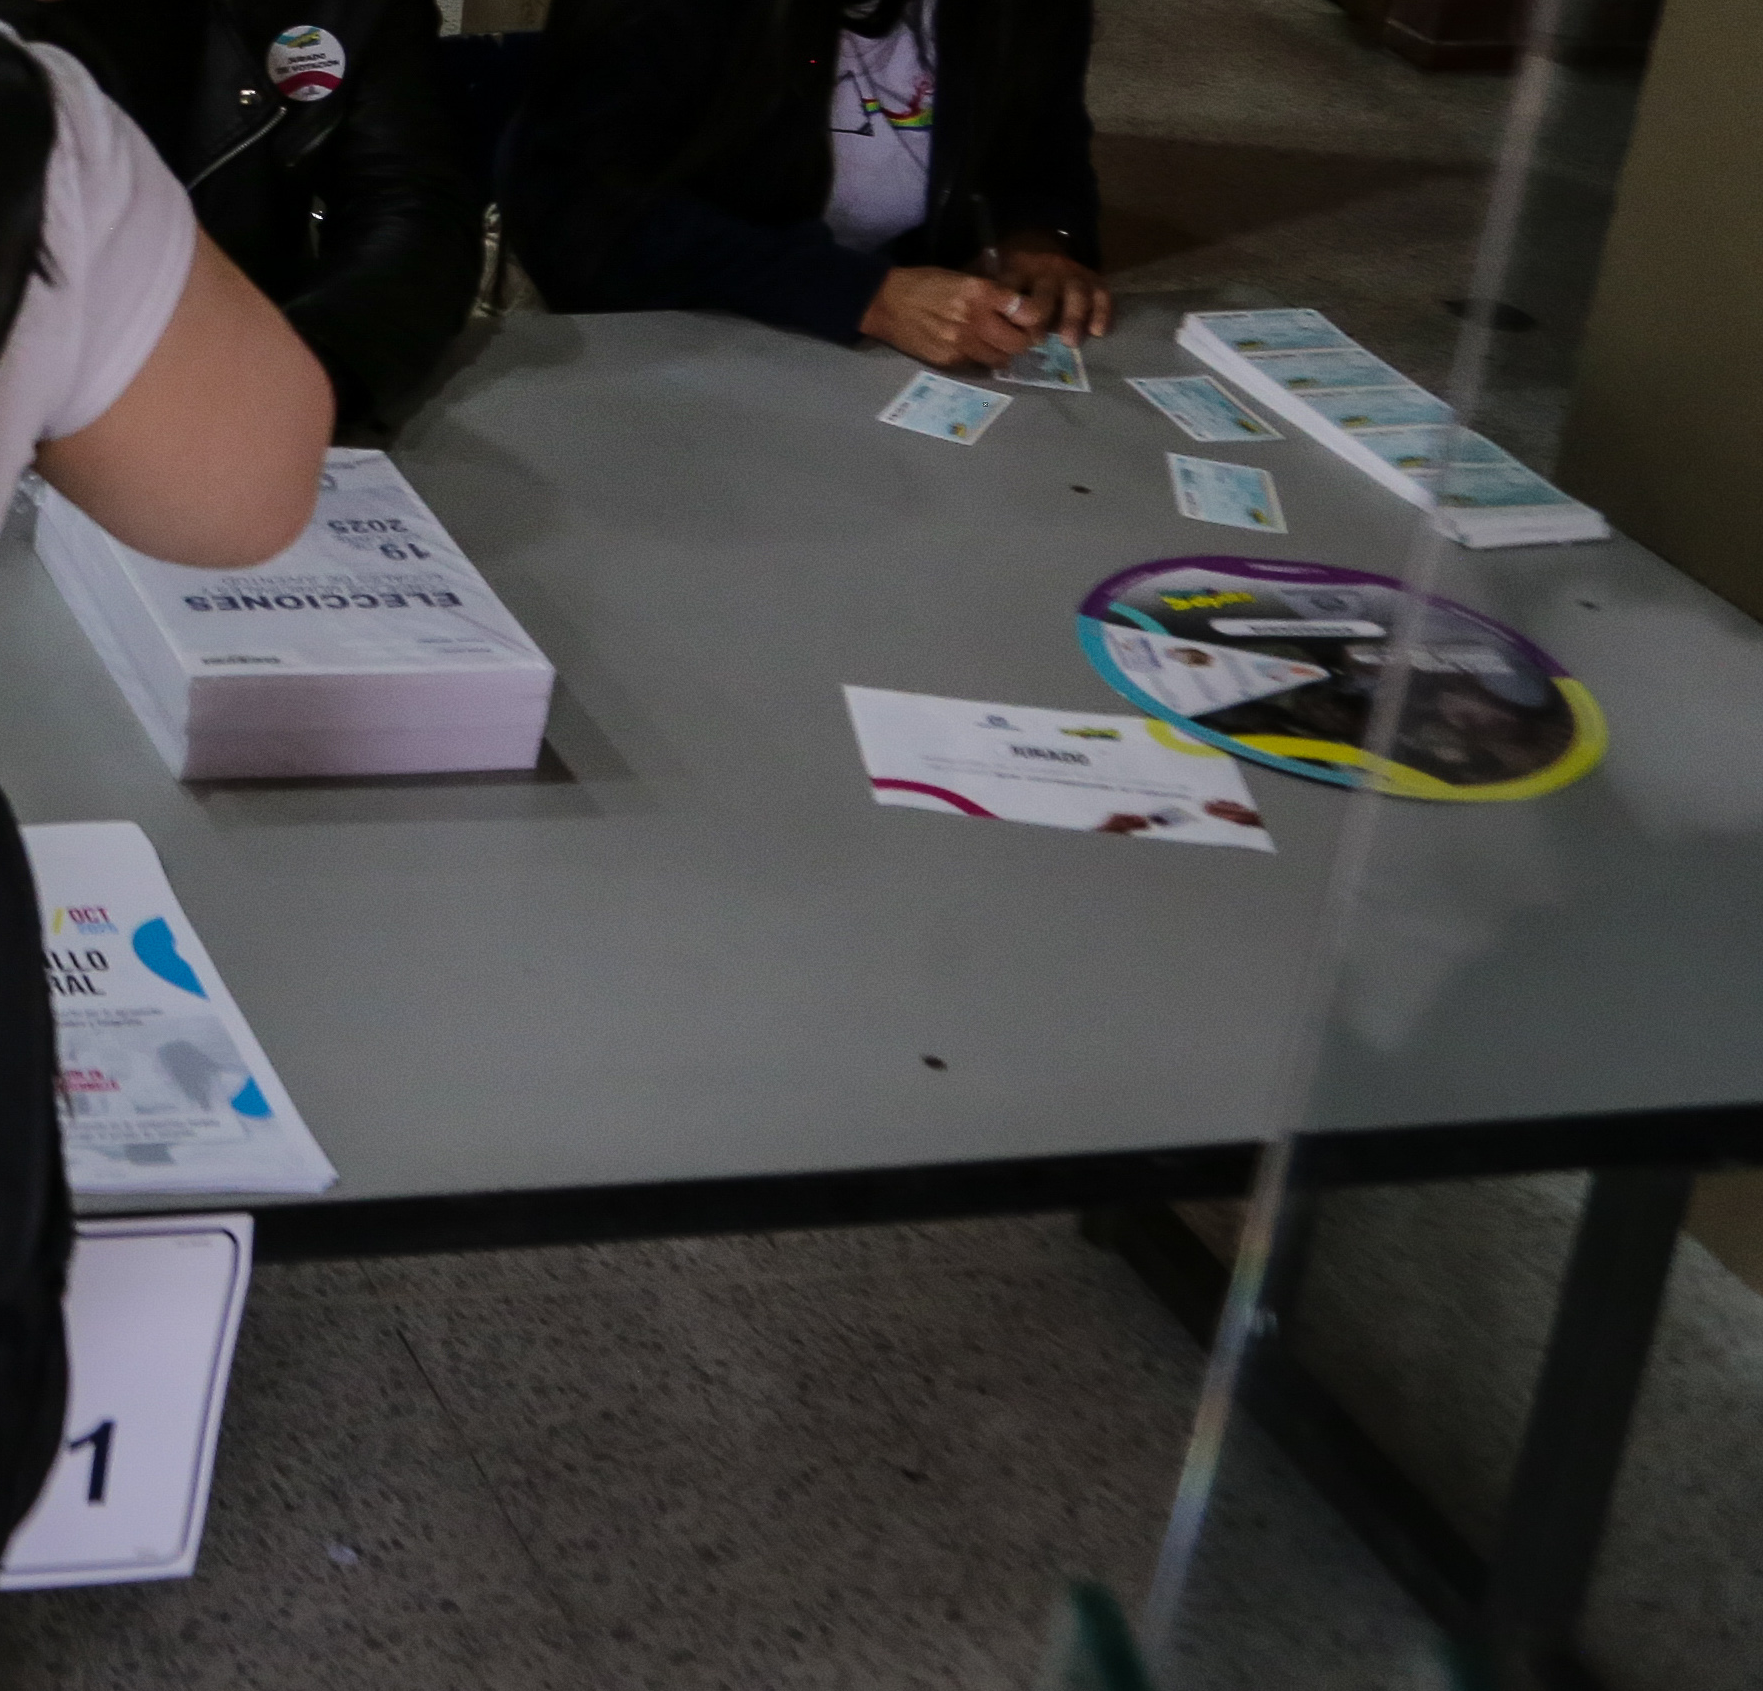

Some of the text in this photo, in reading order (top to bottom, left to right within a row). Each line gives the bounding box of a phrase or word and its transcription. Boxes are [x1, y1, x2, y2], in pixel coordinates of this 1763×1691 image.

[326, 518, 409, 536] 2025
[378, 542, 430, 560] 19
[184, 591, 463, 611] ELECCIONES
[68, 907, 111, 924] OCT
[45, 949, 109, 972] LLO
[68, 1420, 115, 1504] 1
